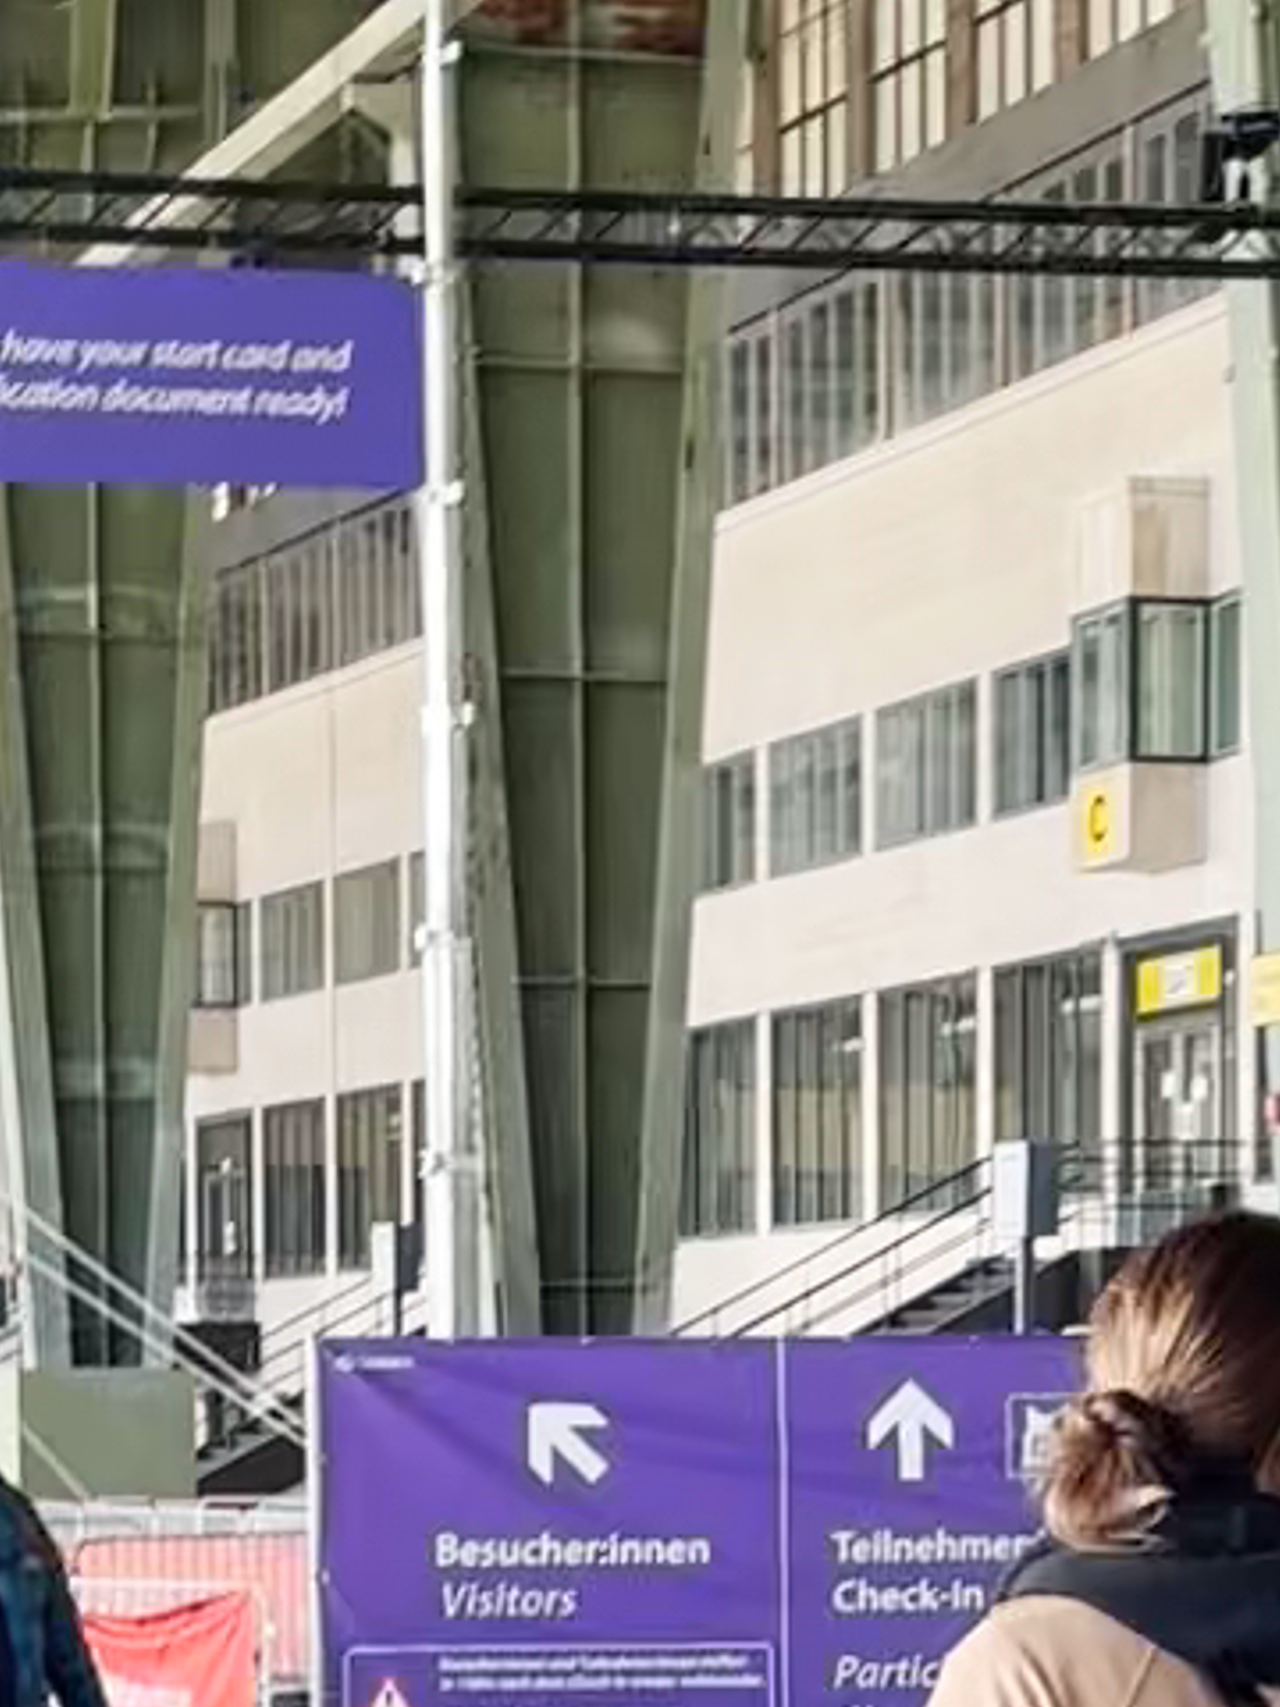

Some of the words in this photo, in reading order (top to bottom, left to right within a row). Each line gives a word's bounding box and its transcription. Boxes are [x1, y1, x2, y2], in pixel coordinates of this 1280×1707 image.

[0, 328, 70, 365] have
[74, 339, 150, 374] your
[150, 340, 220, 371] start
[221, 340, 292, 371] card
[290, 340, 354, 373] and
[100, 378, 252, 416] document
[252, 386, 350, 426] ready!
[1089, 794, 1109, 843] C
[434, 1530, 712, 1568] Besucher:innen
[442, 1580, 579, 1619] Visitors
